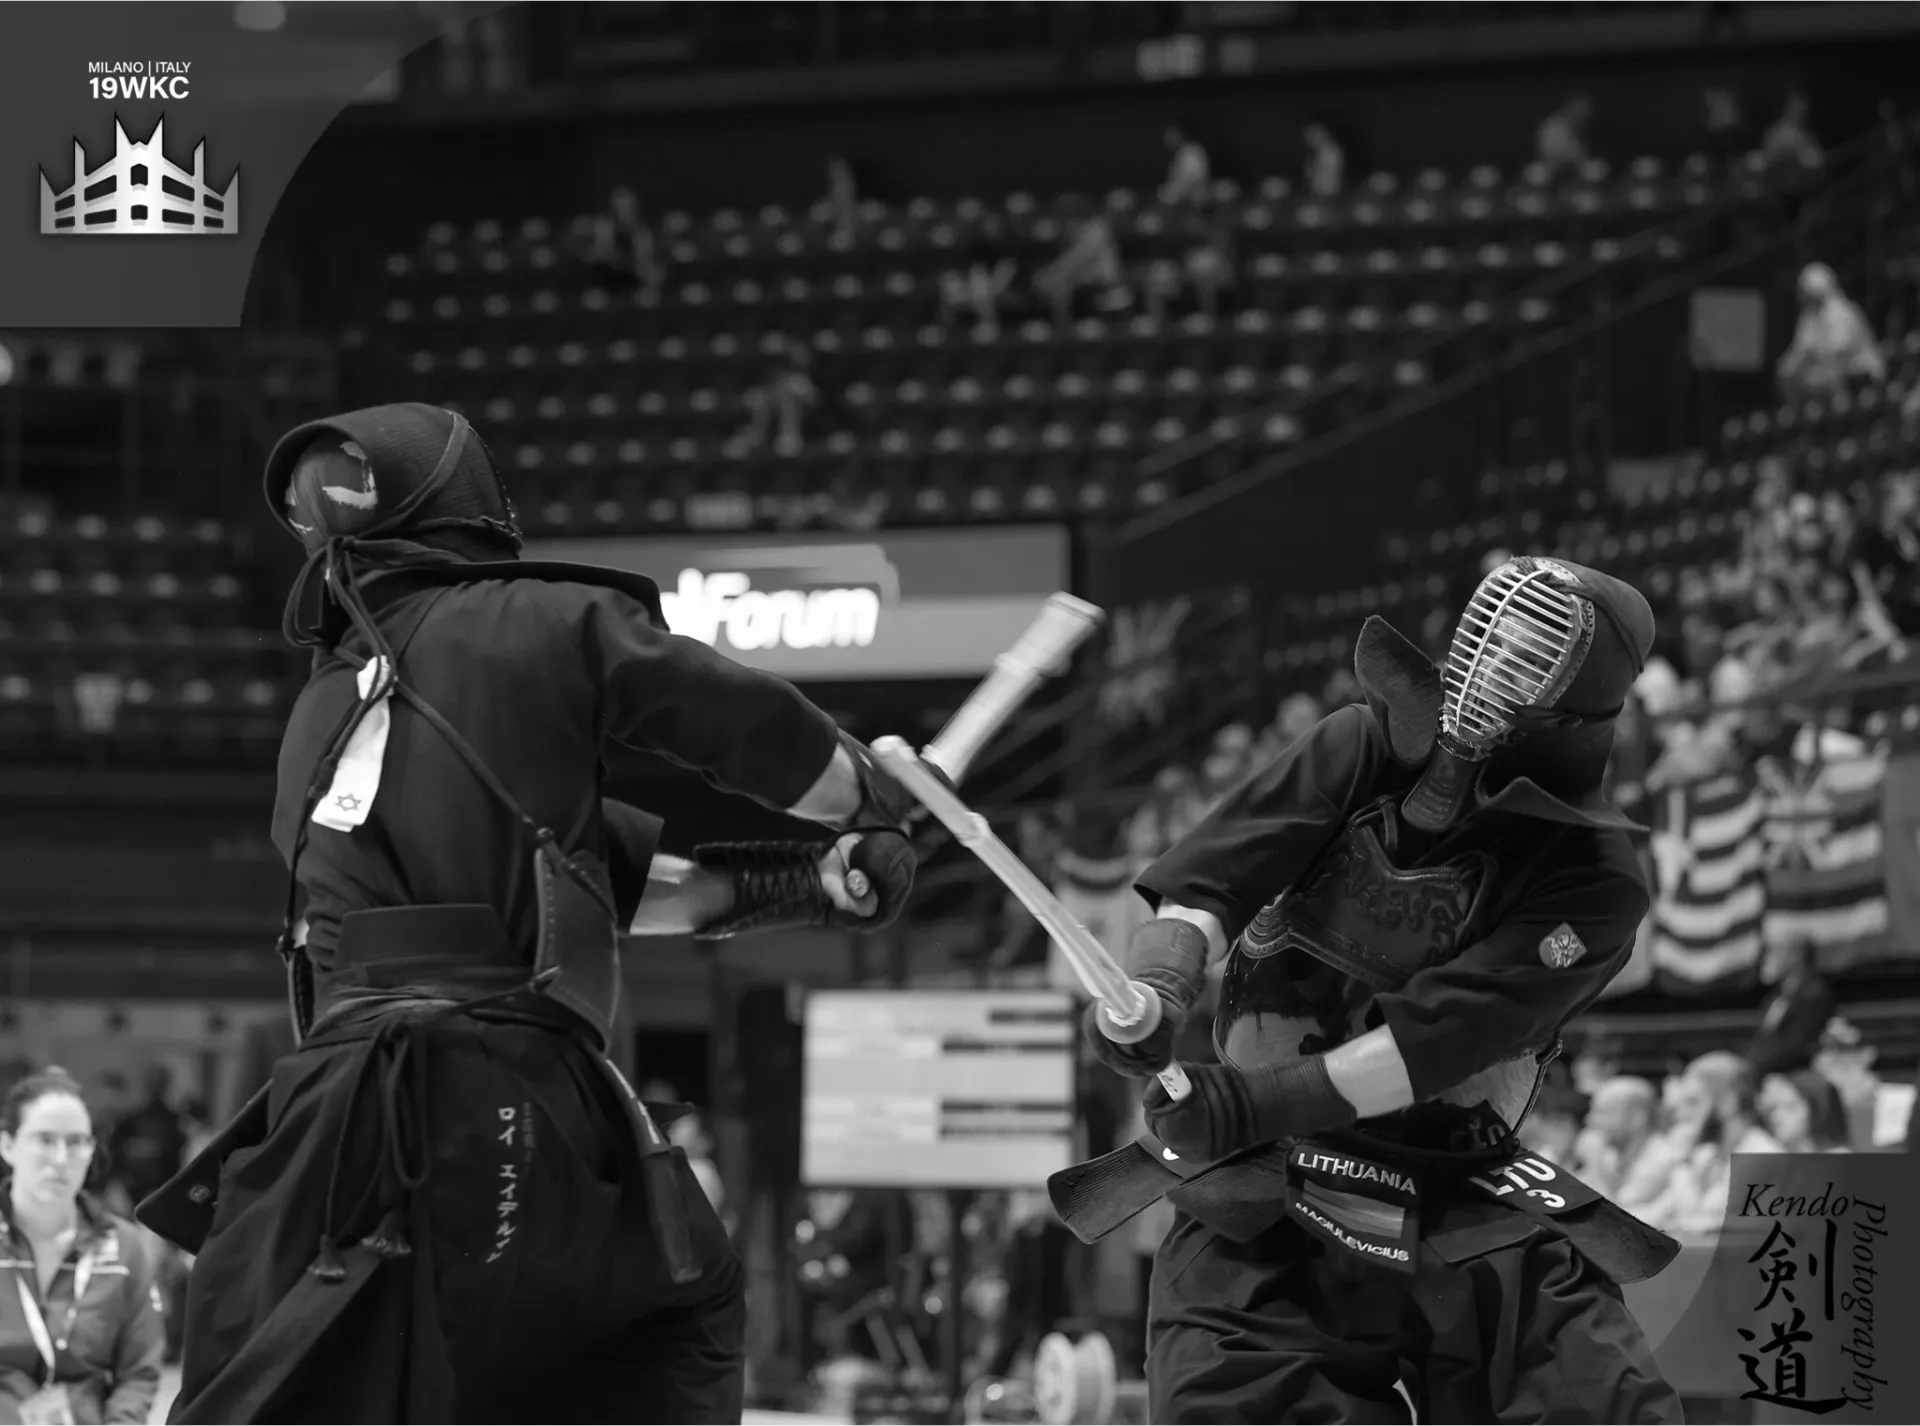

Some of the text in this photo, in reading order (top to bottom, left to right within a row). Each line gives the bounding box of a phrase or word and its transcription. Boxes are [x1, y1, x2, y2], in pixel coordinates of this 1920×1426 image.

[1297, 1152, 1417, 1196] LITHUANIA
[1468, 1158, 1556, 1196] LTU
[1526, 1188, 1566, 1208] 3
